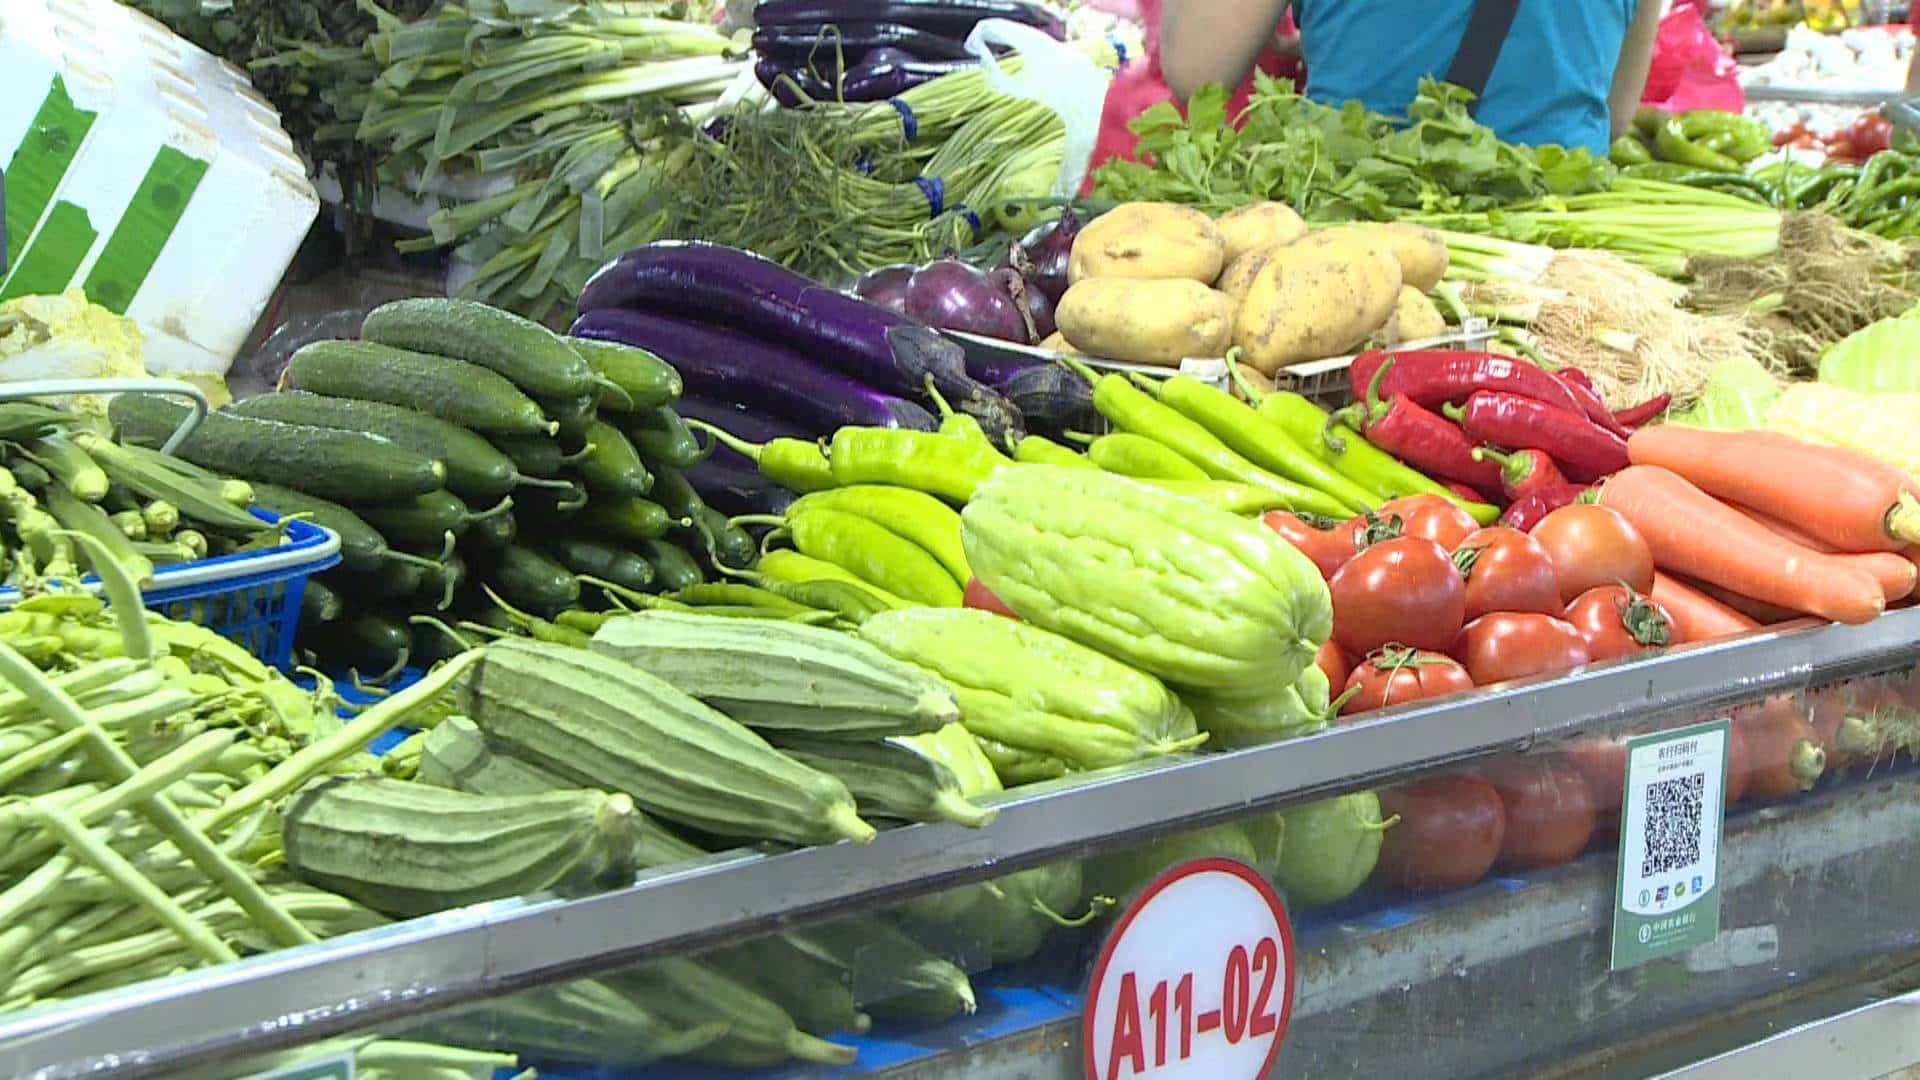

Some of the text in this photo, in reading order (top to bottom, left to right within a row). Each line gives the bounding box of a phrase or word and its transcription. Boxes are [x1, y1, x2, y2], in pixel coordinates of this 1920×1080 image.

[1652, 913, 1696, 932] 中国农业银行
[1107, 937, 1278, 1080] A11-02
